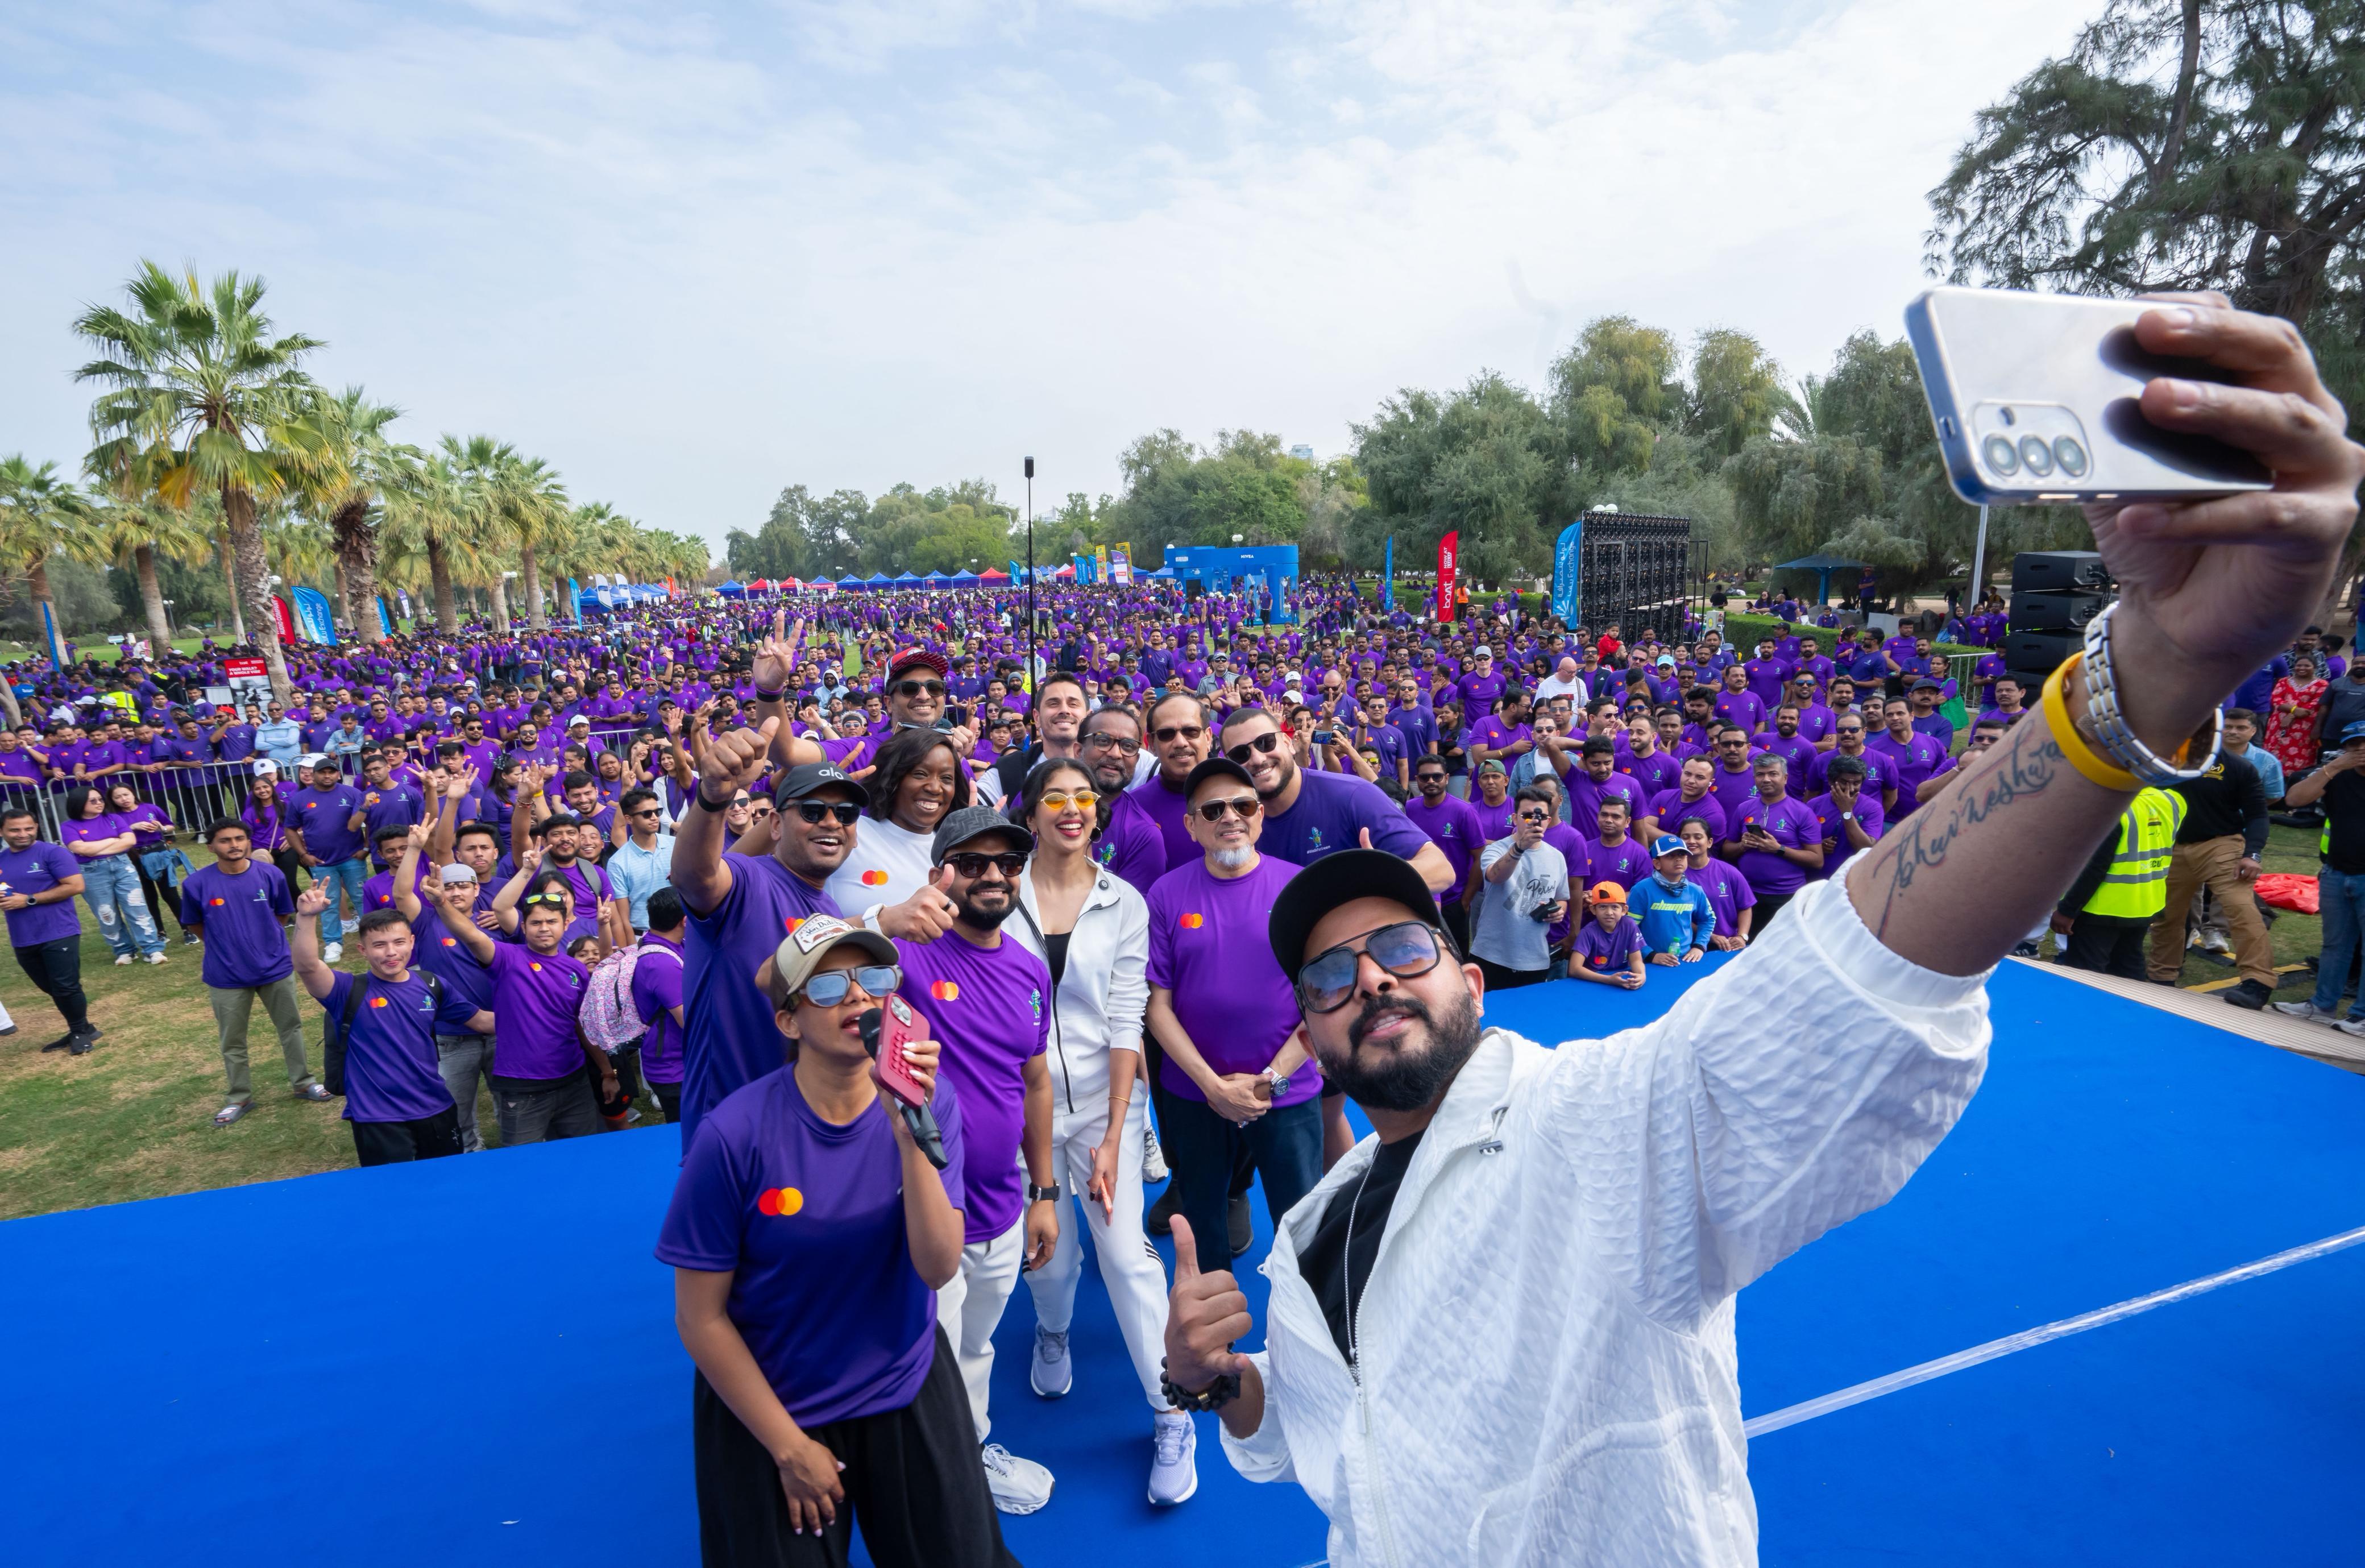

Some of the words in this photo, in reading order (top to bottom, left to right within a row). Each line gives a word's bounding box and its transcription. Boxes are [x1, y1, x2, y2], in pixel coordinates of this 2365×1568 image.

[1567, 541, 1576, 578] Exchange
[1443, 580, 1453, 608] boAt
[272, 599, 283, 620] COMPANY
[316, 603, 326, 630] Exchange
[277, 620, 286, 635] AUDIO
[819, 767, 844, 779] alo
[1650, 899, 1694, 914] champs
